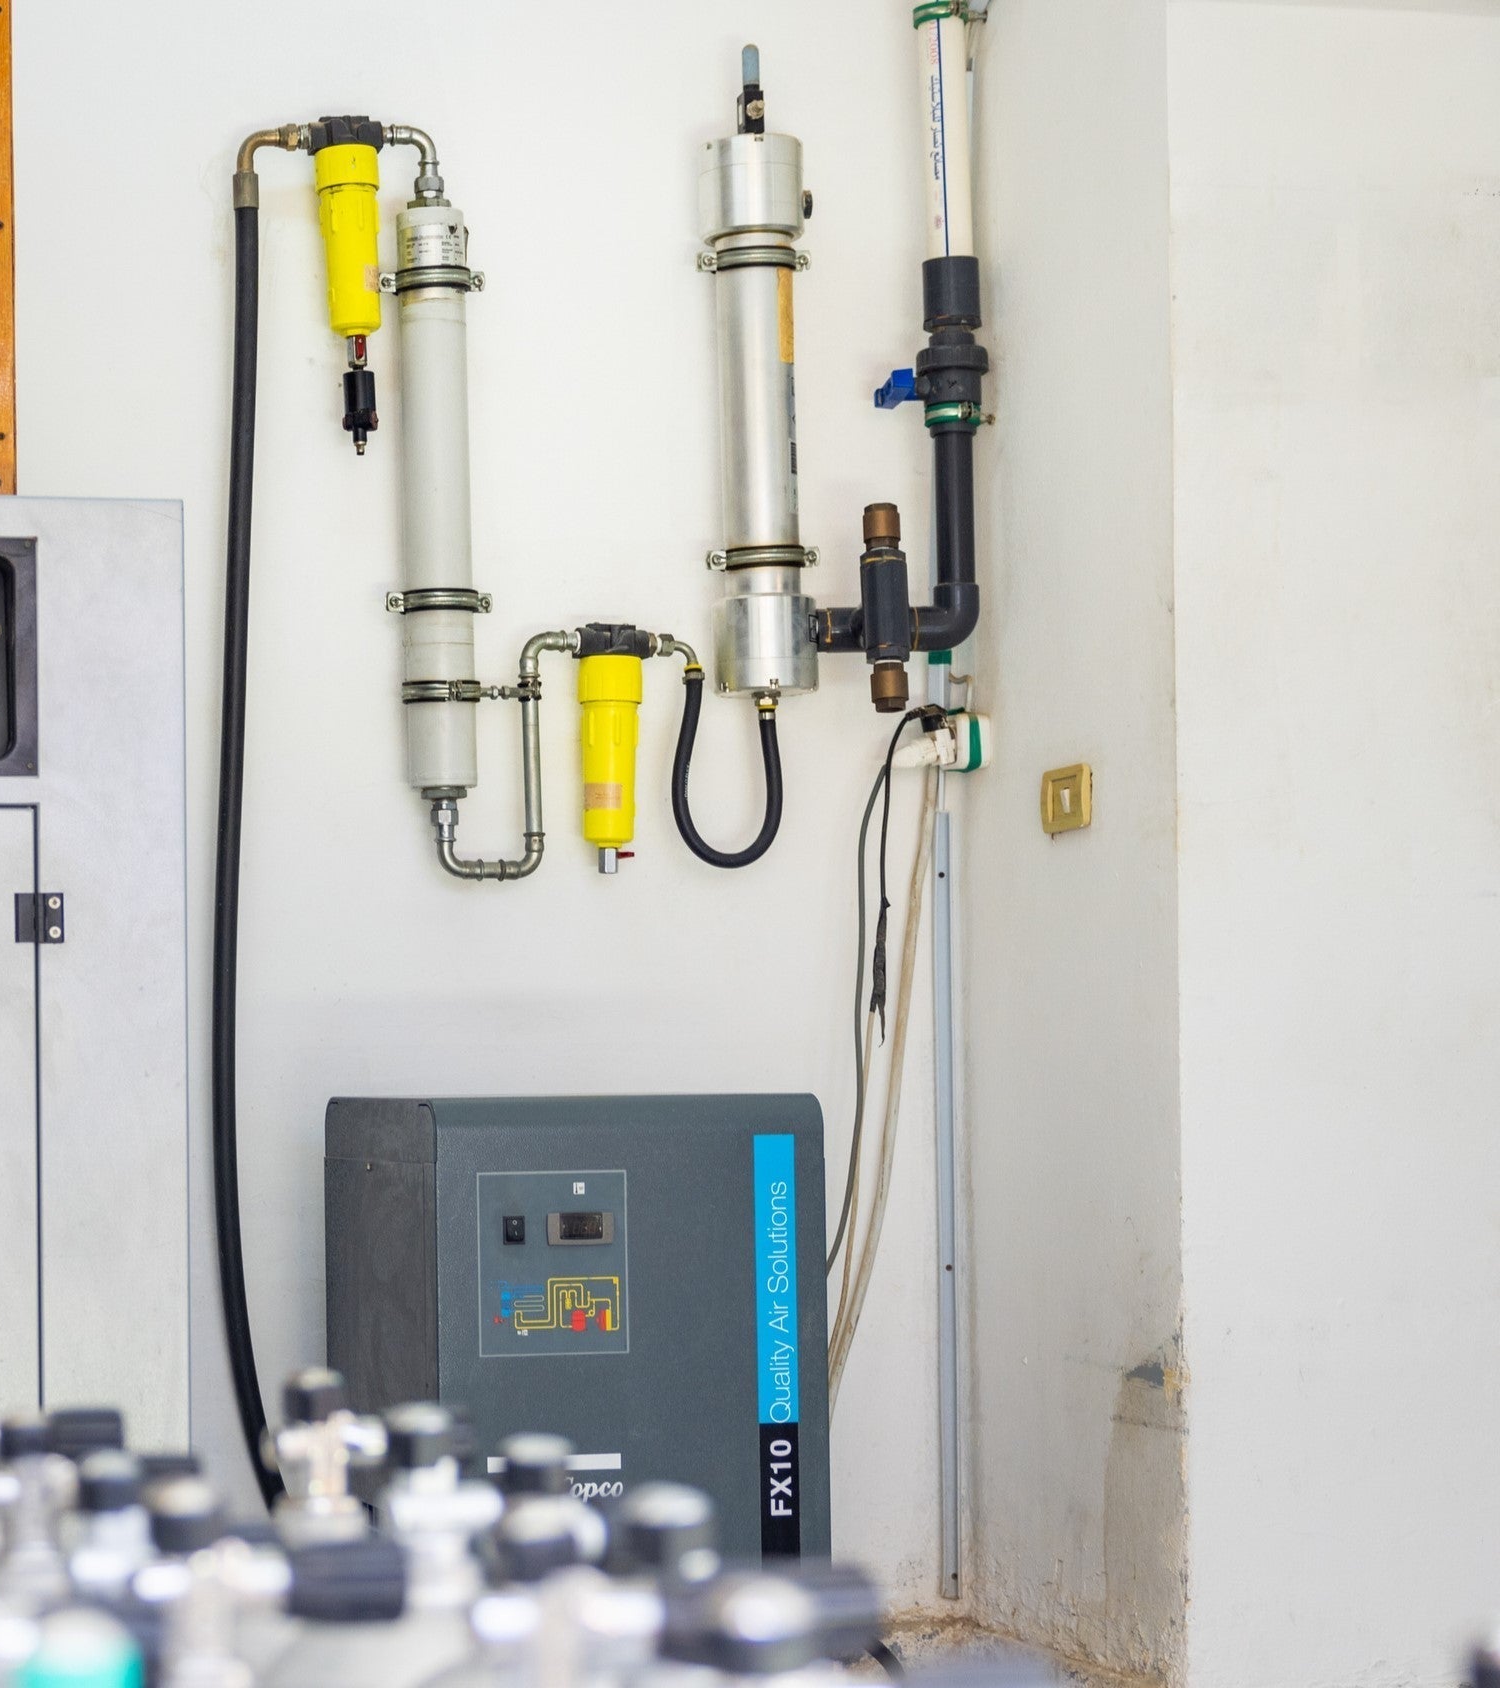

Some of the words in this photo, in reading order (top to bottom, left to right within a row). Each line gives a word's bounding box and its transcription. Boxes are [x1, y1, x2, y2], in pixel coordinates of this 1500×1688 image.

[767, 1180, 788, 1294] Solutions
[768, 1300, 789, 1334] Air
[769, 1339, 795, 1424] Quality
[770, 1438, 792, 1517] FX10
